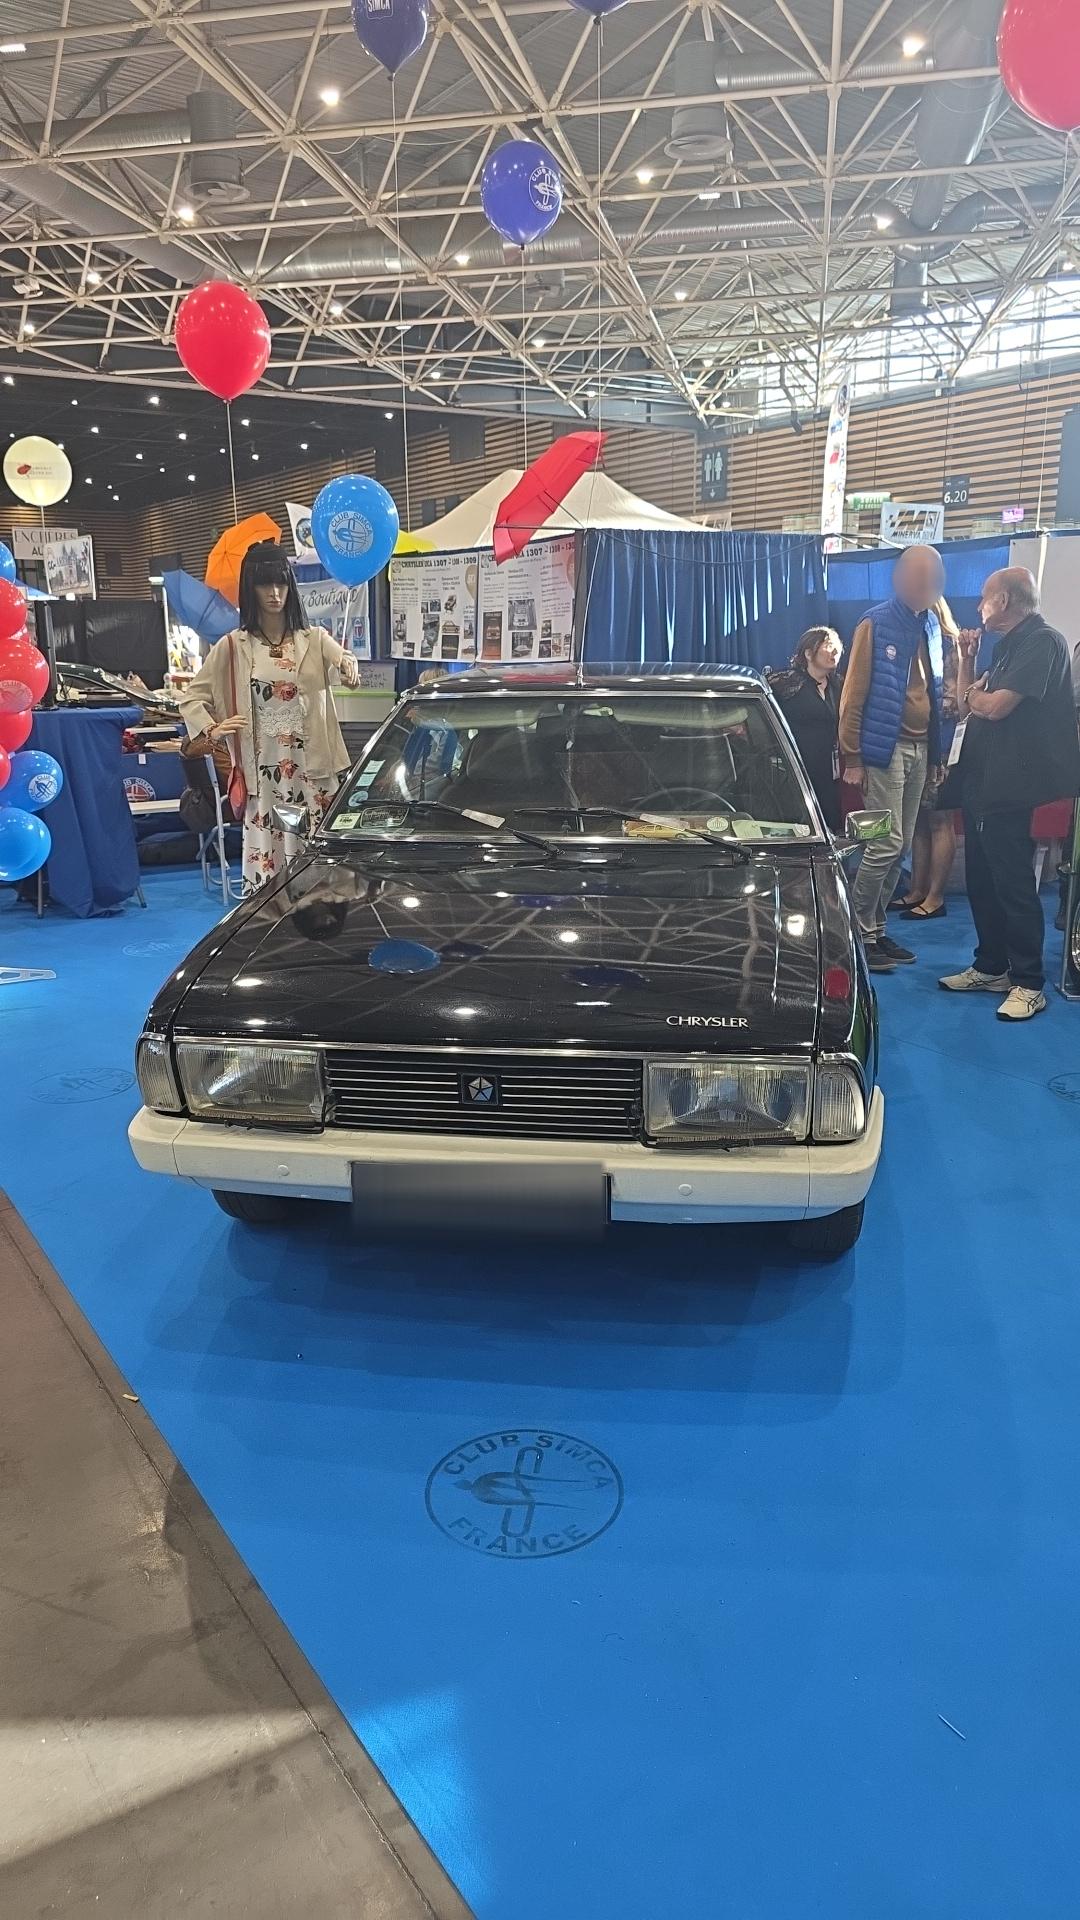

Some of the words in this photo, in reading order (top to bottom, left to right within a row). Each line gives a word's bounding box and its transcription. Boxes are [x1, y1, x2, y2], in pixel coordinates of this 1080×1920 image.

[944, 489, 967, 504] 6.20
[331, 512, 349, 528] CLUB
[891, 531, 921, 539] MINERVA
[526, 547, 543, 558] 1307
[433, 559, 447, 567] 1307
[666, 1015, 749, 1028] CHRYSLER
[444, 1434, 520, 1475] CLUB
[535, 1434, 614, 1489] SIMCA
[448, 1516, 588, 1553] FRANCE
